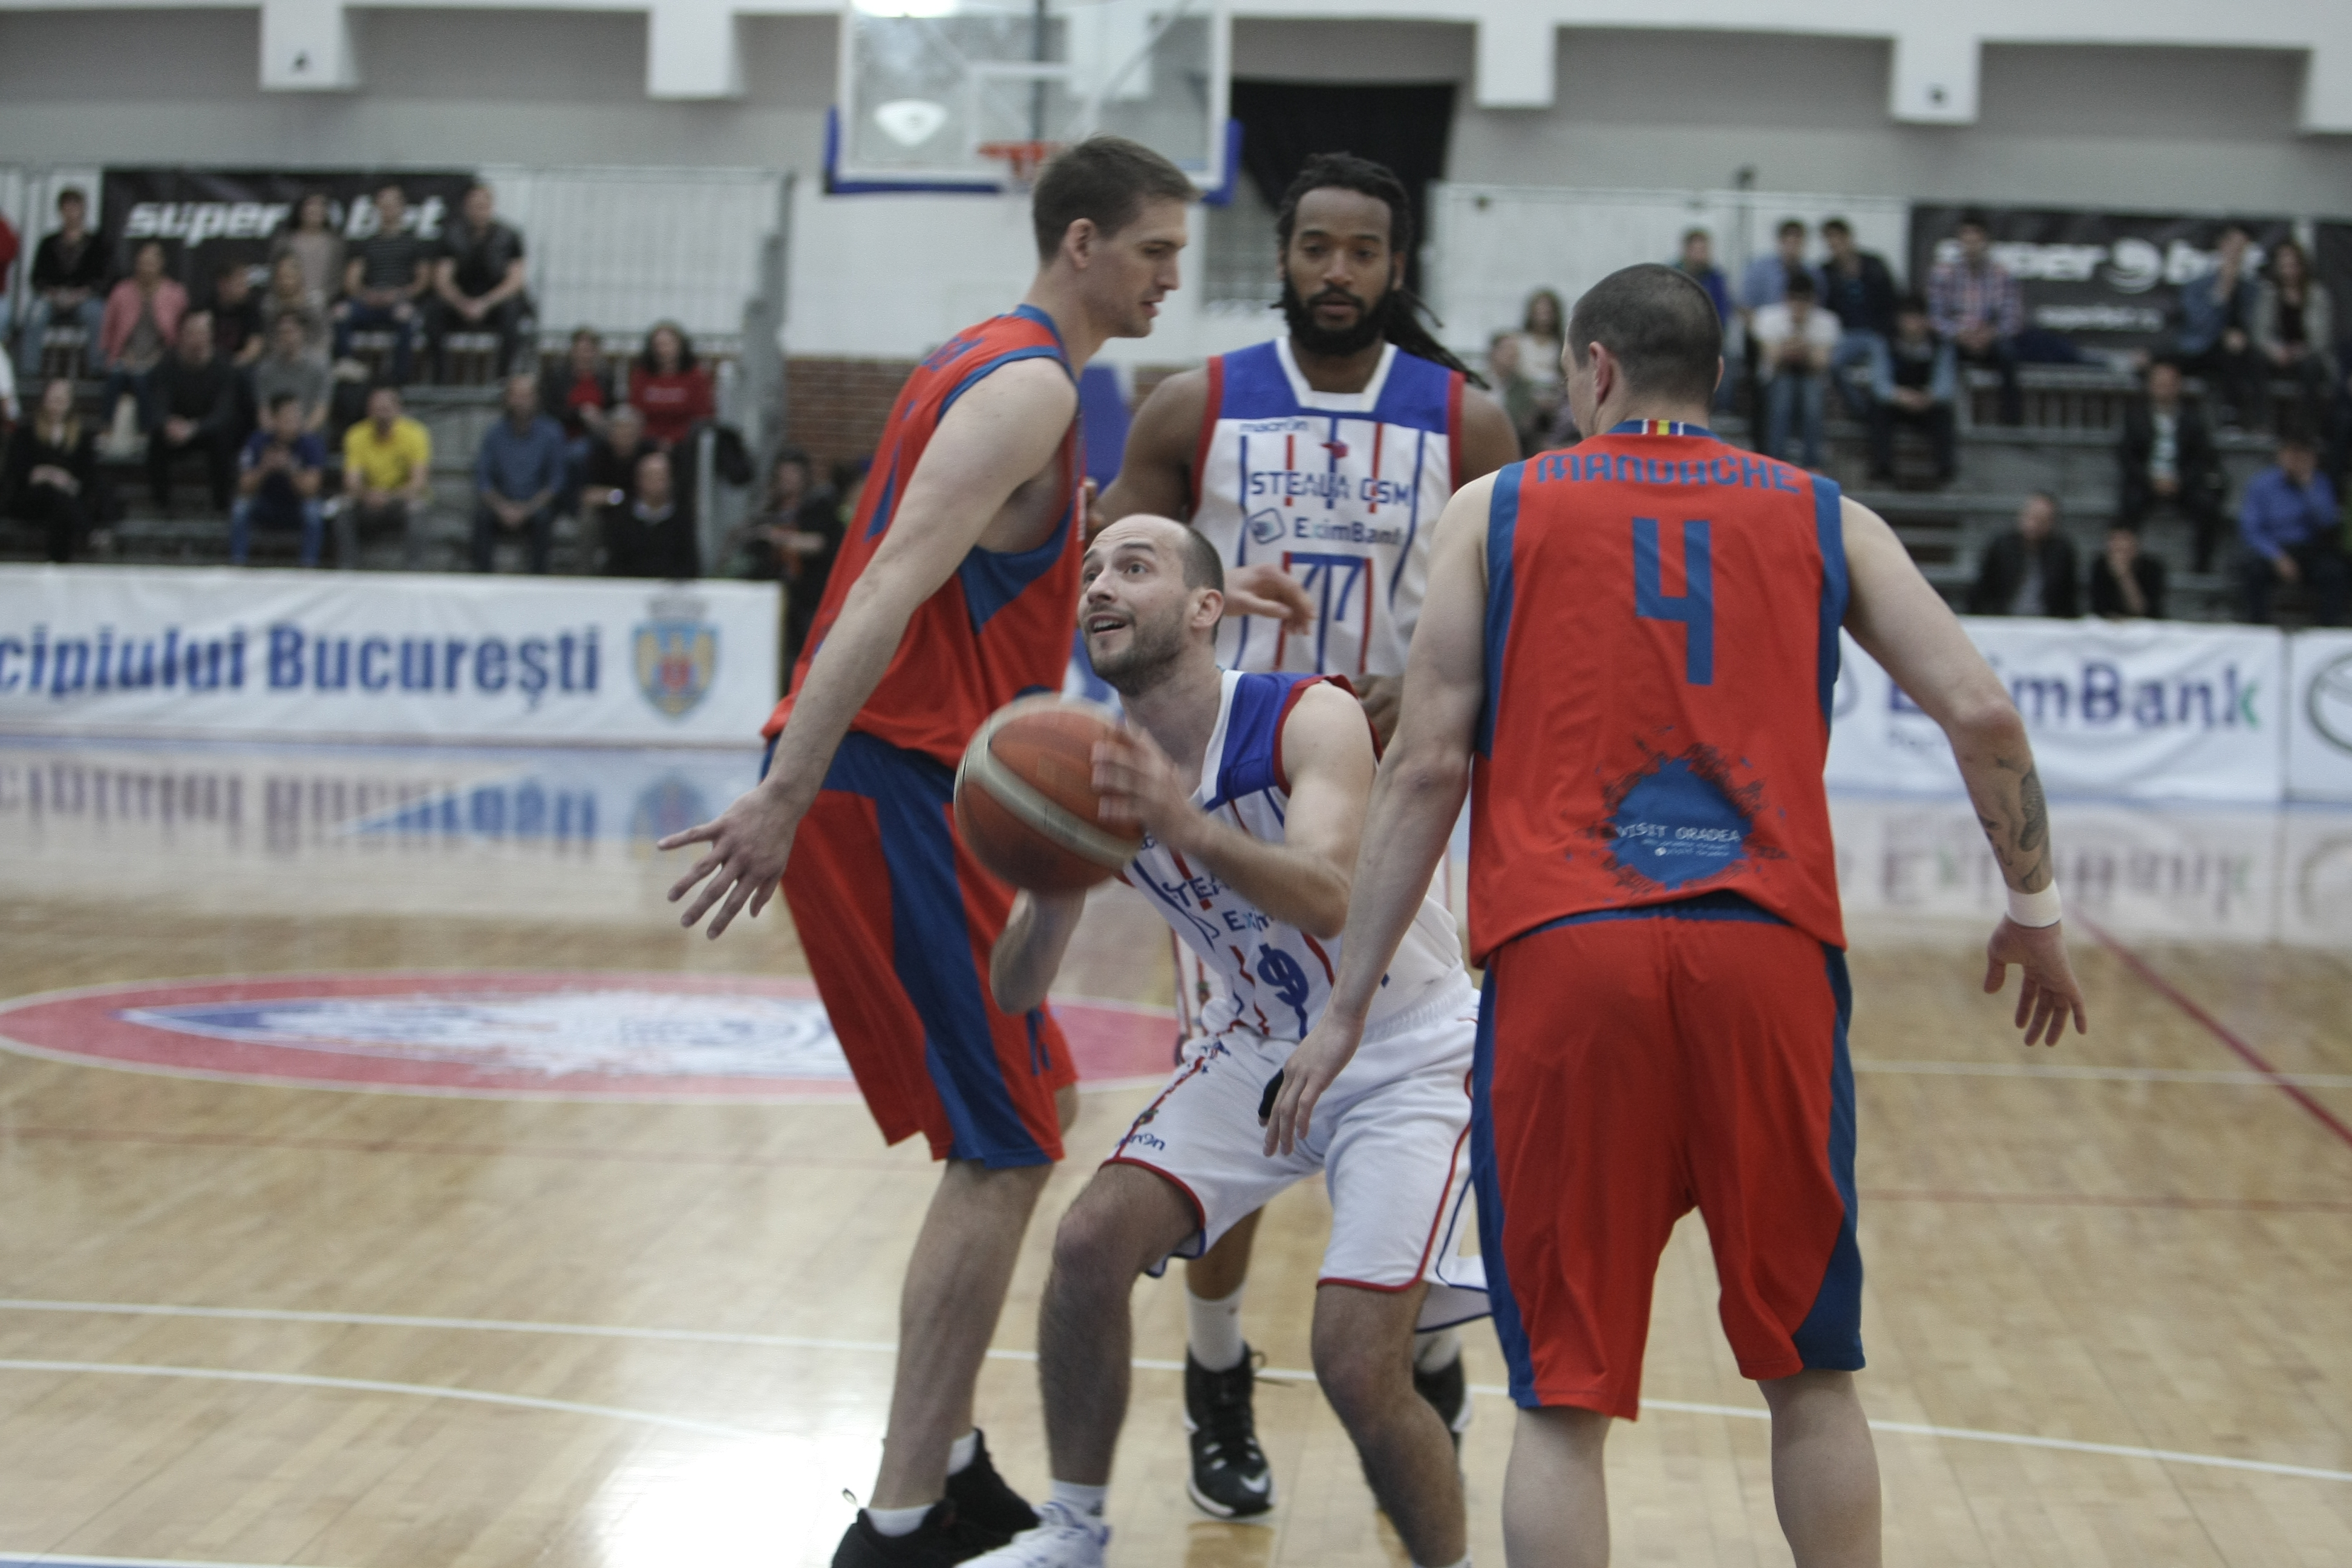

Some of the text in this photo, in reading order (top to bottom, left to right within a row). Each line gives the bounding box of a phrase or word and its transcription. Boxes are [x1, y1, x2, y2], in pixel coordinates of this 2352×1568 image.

[123, 202, 292, 249] super
[1360, 475, 1414, 507] CSM
[1537, 452, 1800, 494] MANDACHE
[1632, 516, 1714, 686] 4
[1615, 822, 1741, 843] VISIT ORADEA
[1256, 947, 1310, 1008] 9
